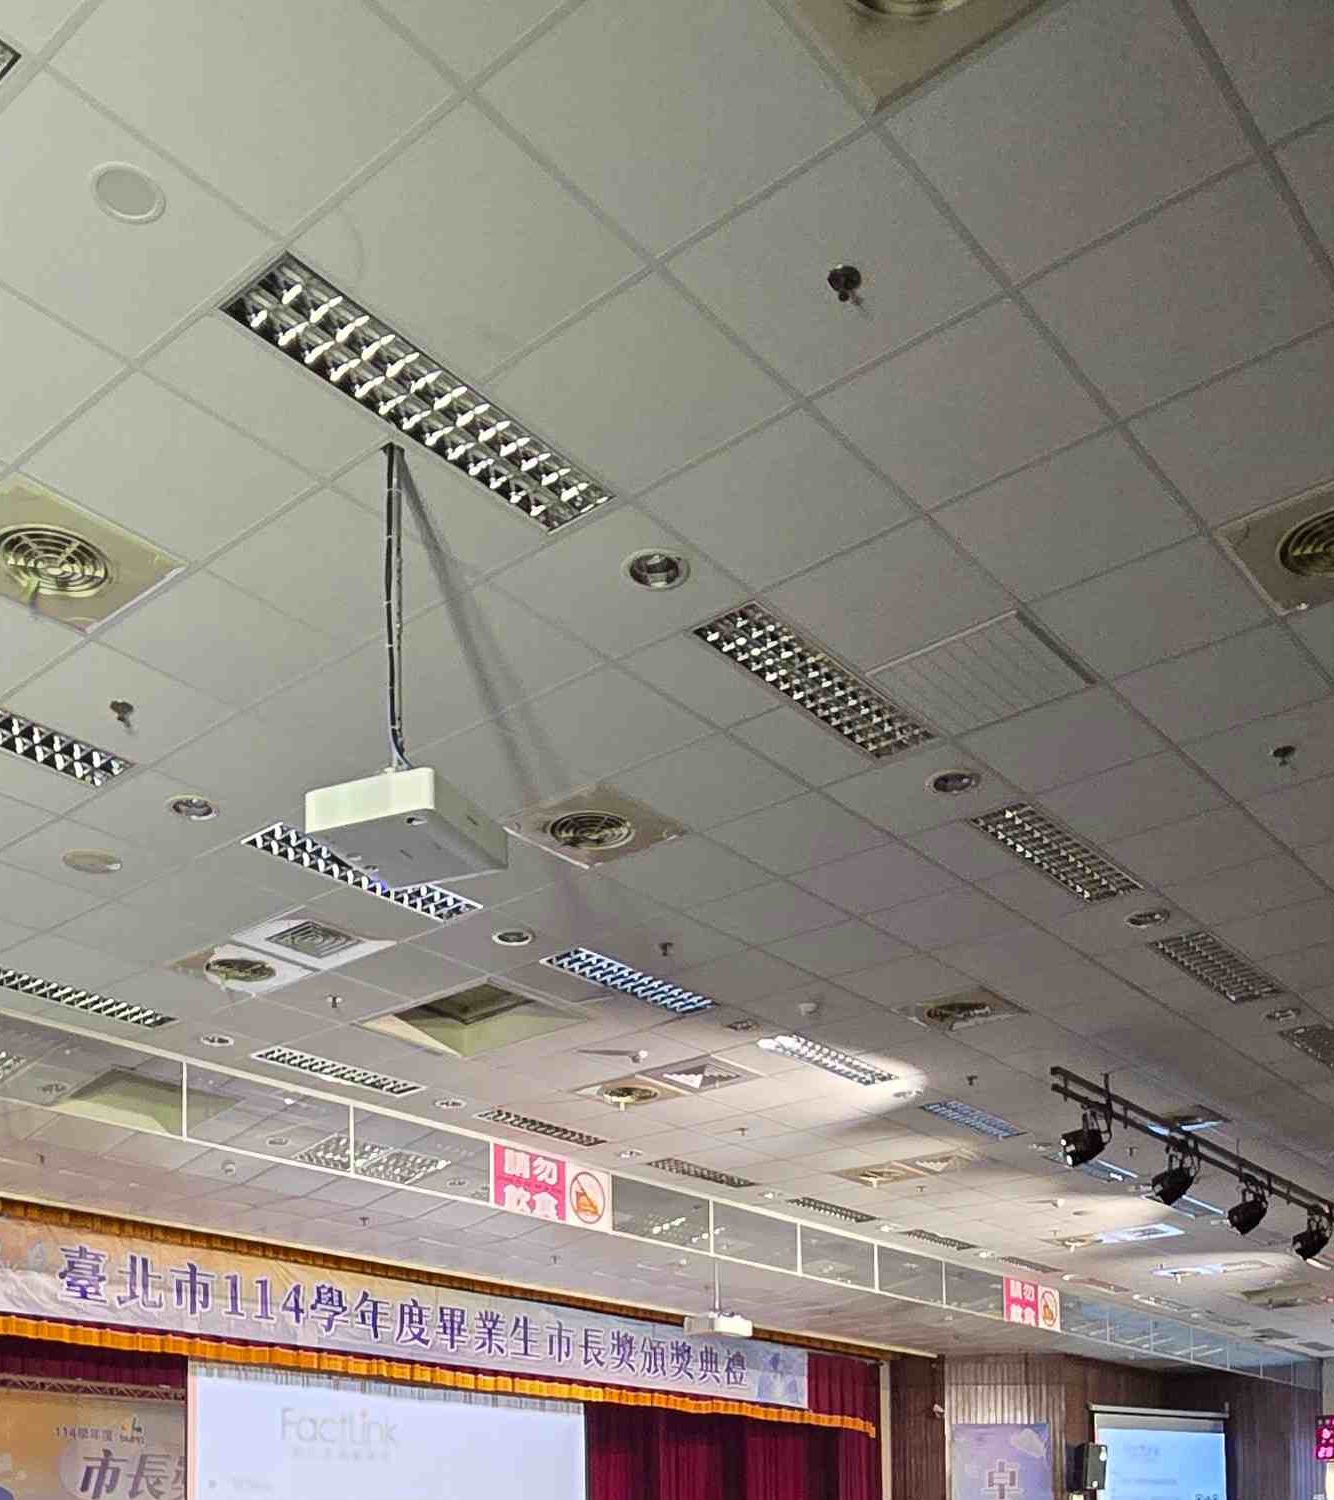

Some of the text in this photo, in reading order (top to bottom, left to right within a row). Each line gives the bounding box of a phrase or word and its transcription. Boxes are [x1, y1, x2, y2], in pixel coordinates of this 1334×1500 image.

[58, 1245, 748, 1387] 臺北市114學年度畢業生市長獎頒獎典禮
[281, 1407, 396, 1447] FactLink
